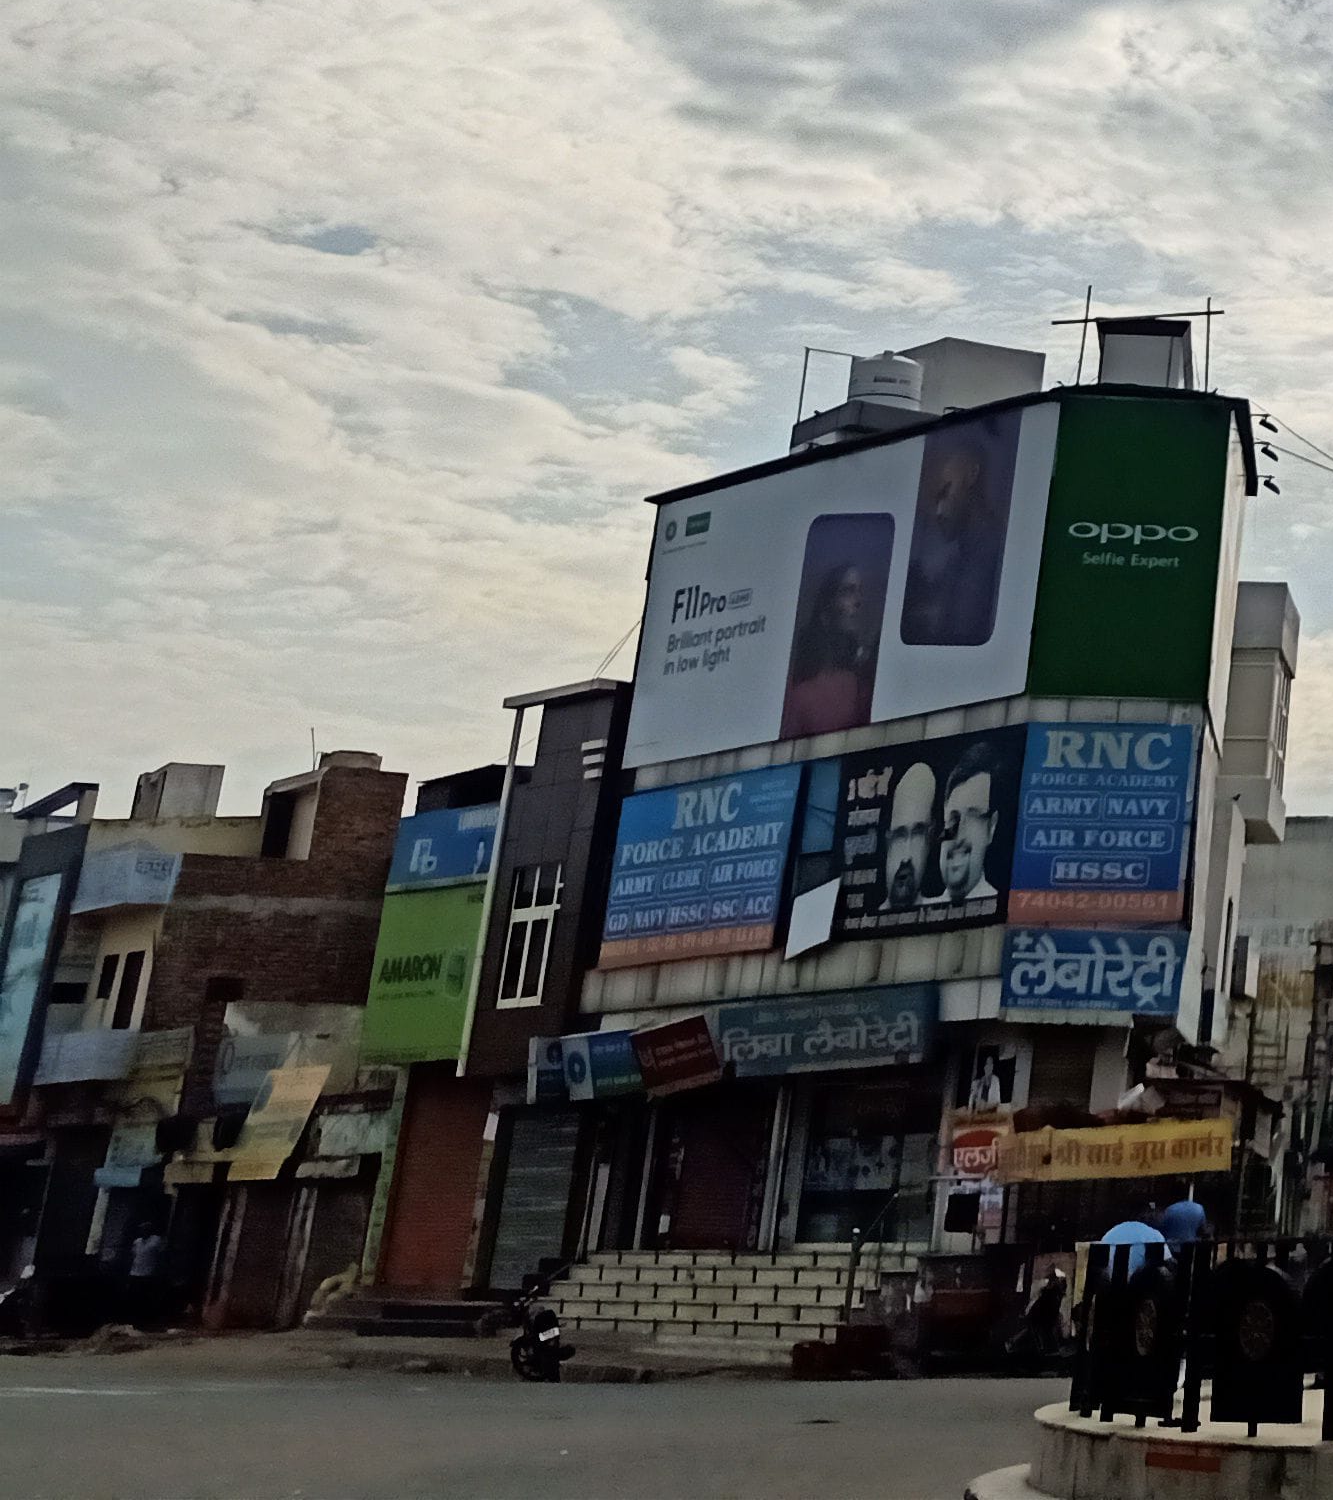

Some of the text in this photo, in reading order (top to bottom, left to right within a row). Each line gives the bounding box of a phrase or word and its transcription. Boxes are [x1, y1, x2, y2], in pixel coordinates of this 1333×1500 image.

[1069, 521, 1199, 546] oppo
[1082, 551, 1181, 569] Selfie Expert
[666, 614, 767, 654] Brilliant portrait
[663, 646, 731, 676] in low light
[1042, 730, 1172, 771] RNC
[1030, 773, 1179, 788] FORCE ACADEMY
[672, 781, 742, 830] RNC
[1028, 796, 1170, 816] ARMY NAVY
[619, 821, 784, 867] FORCE ACADEMY
[1030, 829, 1167, 848] AIR FORCE
[612, 875, 656, 898] ARMY
[711, 863, 734, 884] AIR
[735, 858, 778, 881] FORCE
[1054, 861, 1145, 880] HSSC
[608, 912, 629, 932] GD
[633, 908, 666, 929] NAVY
[669, 903, 706, 925] HSSC
[711, 899, 739, 919] SSC
[379, 951, 445, 984] AMARON
[1010, 931, 1181, 1008] लैबोरेट्री
[802, 1011, 919, 1054] लैबोरेट्री
